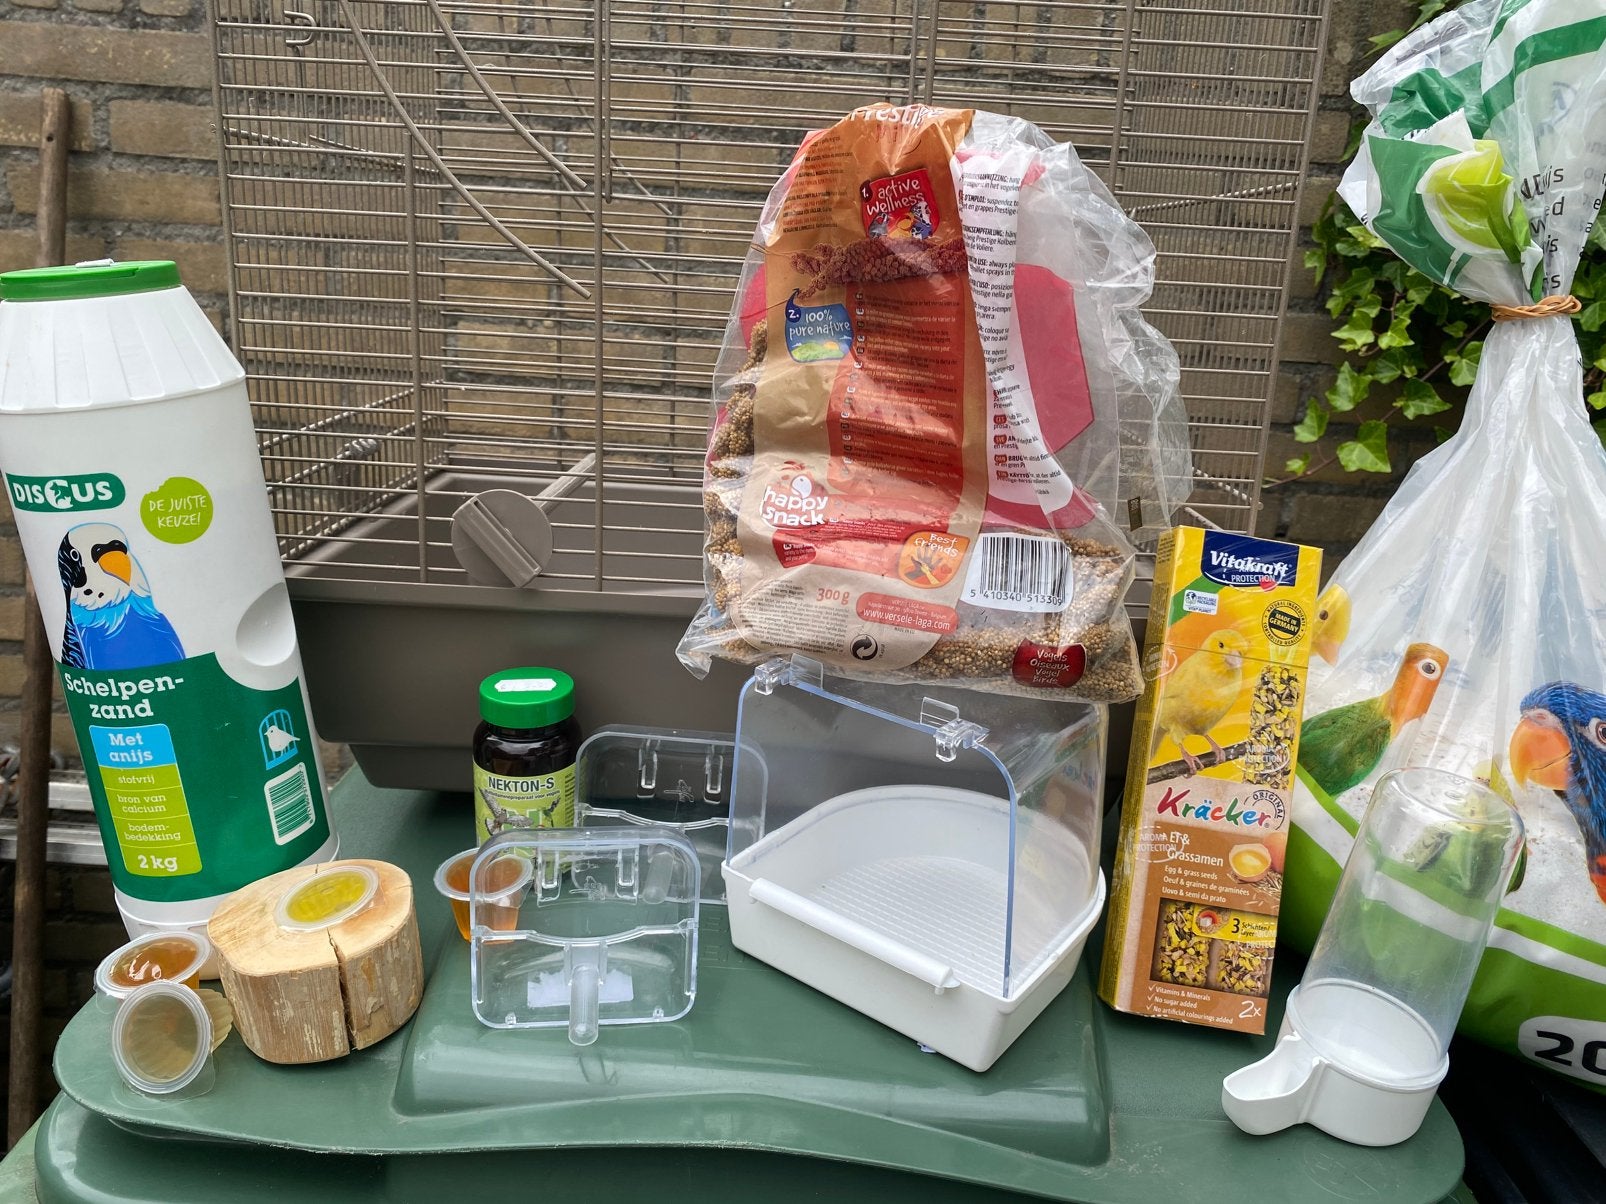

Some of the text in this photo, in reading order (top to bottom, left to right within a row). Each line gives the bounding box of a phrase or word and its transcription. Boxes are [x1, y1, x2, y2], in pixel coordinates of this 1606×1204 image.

[878, 179, 920, 198] active
[866, 193, 925, 216] wellness
[788, 309, 833, 323] 2. 100%
[790, 326, 813, 341] pure
[817, 321, 850, 336] nature
[13, 479, 113, 509] DISCUS
[763, 485, 828, 512] happy
[149, 495, 207, 512] DE JUISTE
[157, 512, 201, 528] KEUZE!
[763, 506, 825, 526] snack
[914, 537, 959, 557] friends
[930, 533, 958, 546] Best
[1210, 550, 1289, 577] Vitakraft
[1231, 574, 1276, 583] PROTECTION
[816, 588, 840, 602] 300
[841, 591, 850, 605] g
[970, 589, 1062, 606] 5 410340 513309
[863, 608, 950, 630] www.versele-laga.com
[1270, 618, 1299, 632] GERMANY
[1275, 613, 1291, 623] MADE
[1037, 649, 1068, 661] Vogels
[1030, 659, 1070, 671] Oiseaux
[1035, 668, 1060, 677] Vogel
[65, 673, 184, 700] Schelpen-
[89, 699, 154, 719] zand
[108, 732, 144, 746] Met
[110, 749, 153, 764] anijs
[118, 774, 155, 784] stofvrij
[488, 776, 555, 793] NEKTON-S
[117, 794, 166, 803] bron van
[1157, 787, 1271, 826] Kräcker
[1252, 791, 1284, 819] ORIGINAL
[122, 805, 166, 813] calcium
[128, 823, 170, 831] bodem-
[124, 832, 181, 841] bedekking
[138, 854, 178, 872] 2 kg
[1167, 847, 1224, 867] Grassamen
[1164, 865, 1176, 874] Egg
[1184, 869, 1200, 877] grass
[1200, 872, 1218, 880] seeds
[1163, 876, 1178, 884] Oeuf
[1186, 879, 1208, 890] graines
[1218, 885, 1250, 896] graminées
[1162, 887, 1178, 895] Uovo
[1185, 890, 1200, 898] semi
[1209, 894, 1226, 903] prato
[1231, 918, 1240, 933] 3
[1156, 986, 1180, 996] Vitamins
[1186, 991, 1211, 1001] Minerals
[1180, 1001, 1197, 1009] added
[1238, 1000, 1262, 1019] 2x
[1162, 1007, 1186, 1016] artificial
[1186, 1011, 1215, 1022] colourings
[1216, 1015, 1233, 1024] added
